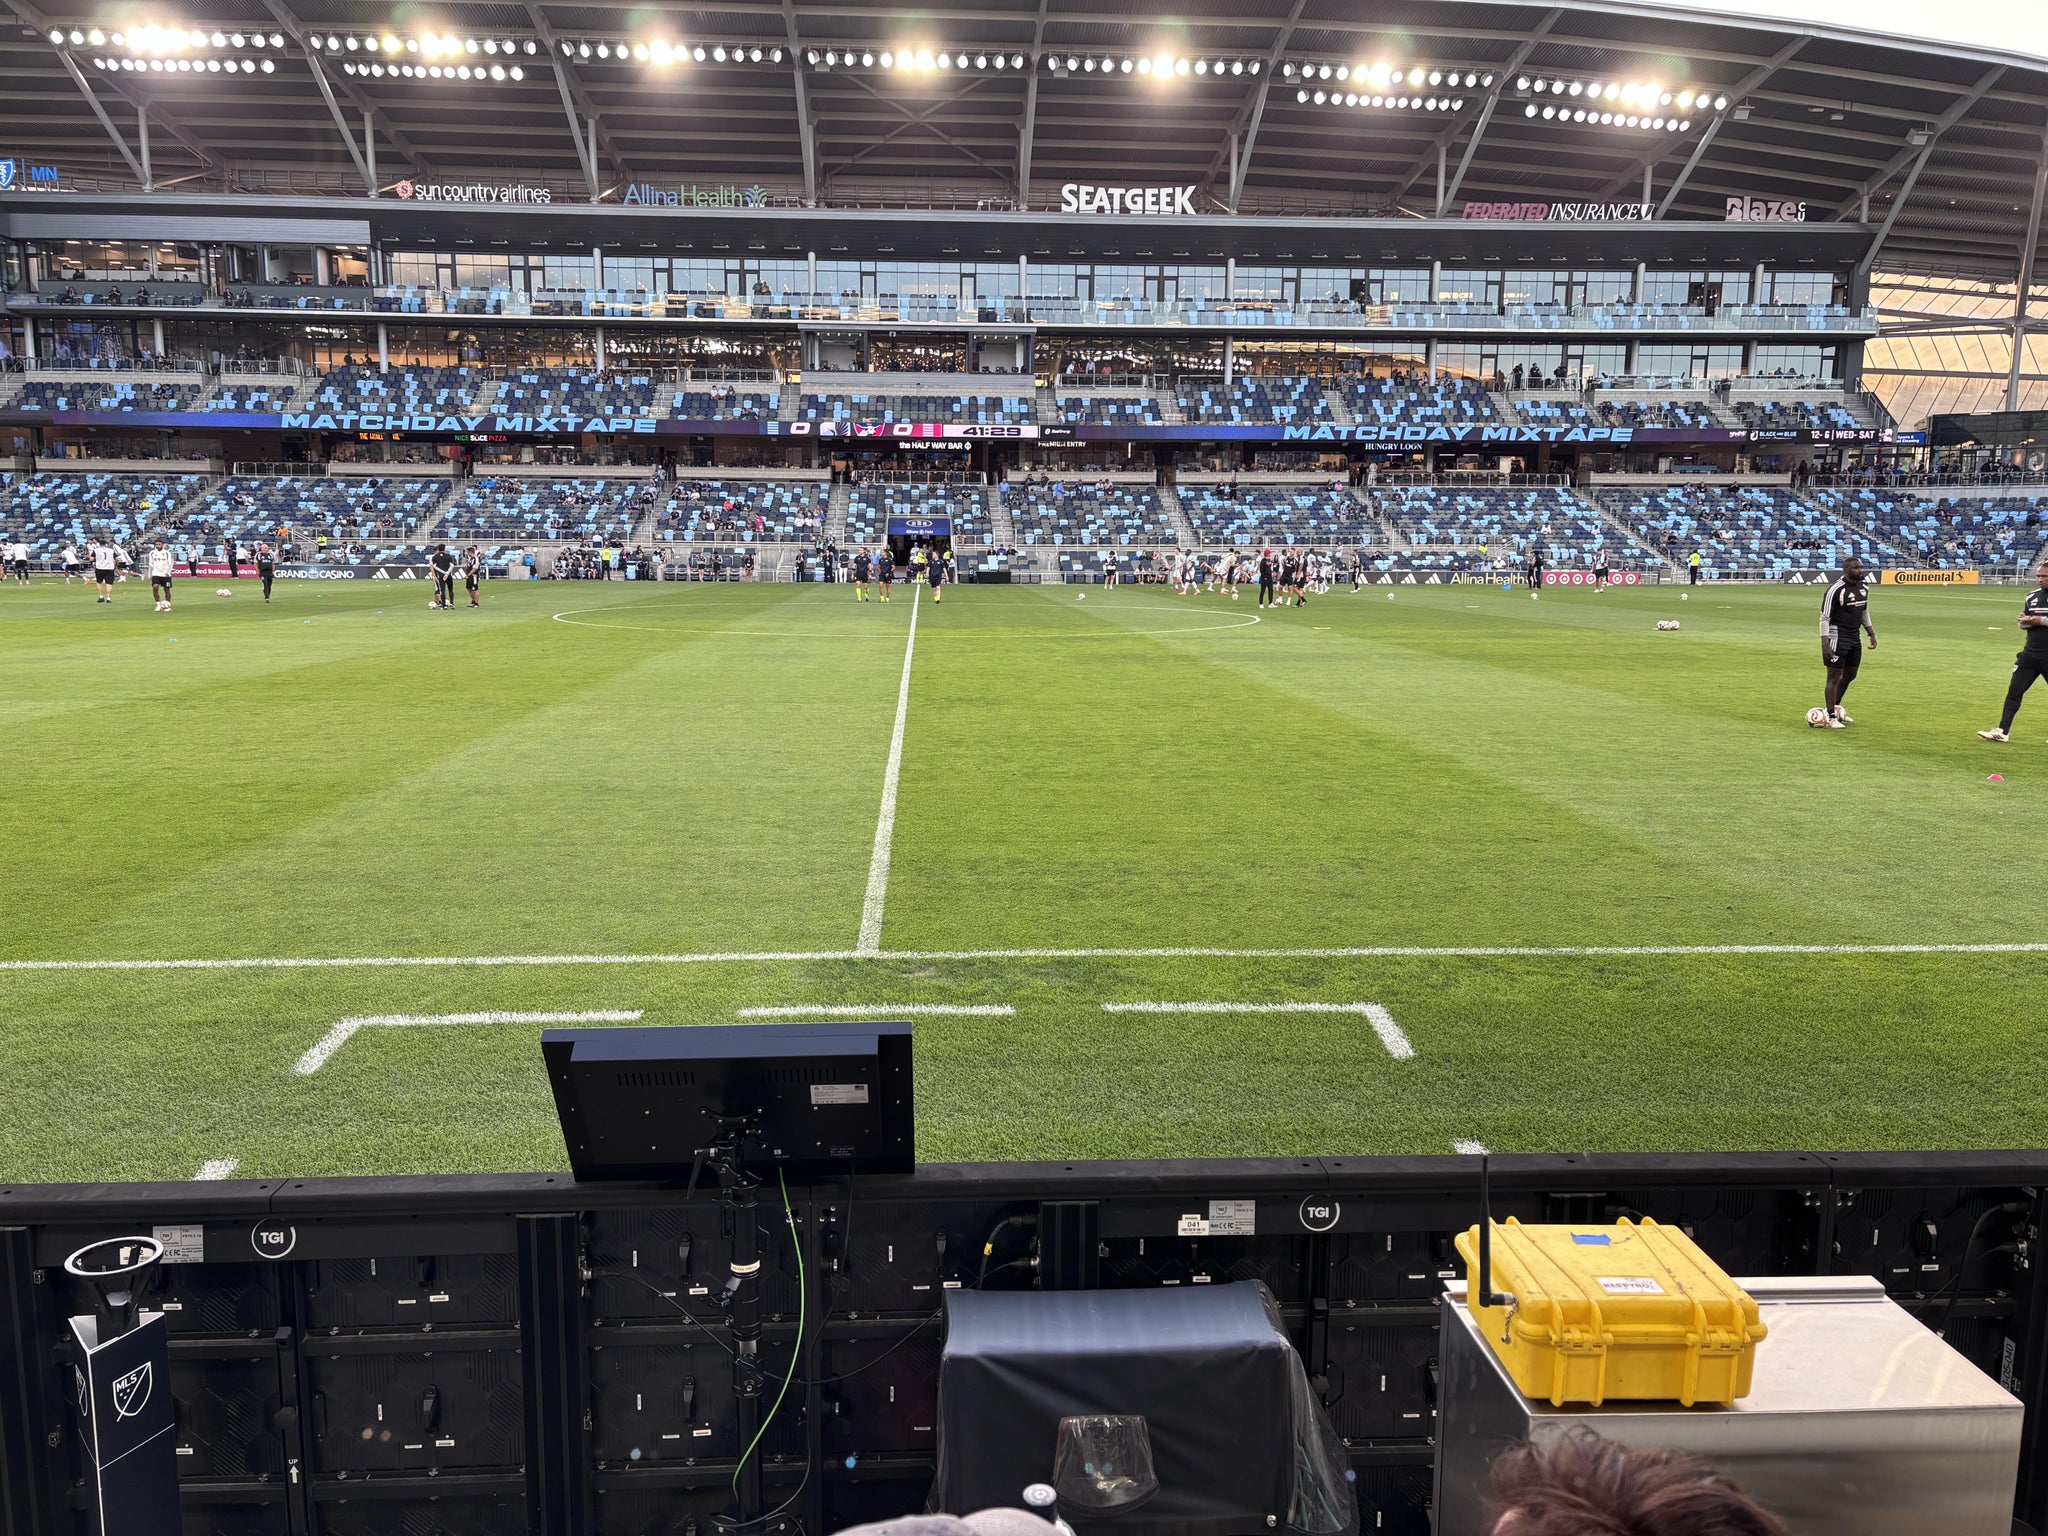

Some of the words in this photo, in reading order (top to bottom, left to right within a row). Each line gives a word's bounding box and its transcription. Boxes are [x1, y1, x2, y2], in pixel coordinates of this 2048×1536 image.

[31, 165, 58, 182] MN
[415, 184, 441, 200] sun
[443, 183, 498, 203] country
[500, 184, 551, 203] airlines
[623, 183, 677, 205] Allina
[680, 184, 743, 206] Health
[1061, 183, 1197, 214] SEATGEEK
[1462, 202, 1549, 220] FEDERATED
[1548, 203, 1642, 221] INSURANCE
[1726, 196, 1797, 221] Blaze
[281, 414, 485, 431] MATCHDAY
[495, 417, 657, 433] MIXTAPE
[962, 426, 1022, 437] 41:29
[454, 434, 470, 442] NICE
[1282, 425, 1474, 441] MATCHDAY
[1481, 427, 1634, 442] MIXTAPE
[1859, 430, 1876, 439] SAT
[899, 441, 911, 449] the
[274, 569, 308, 579] GRAND
[319, 570, 355, 579] CASINO
[1894, 571, 1955, 584] Continental
[1307, 1207, 1329, 1218] TGI
[259, 1232, 284, 1244] TGI
[116, 1373, 137, 1393] MLS
